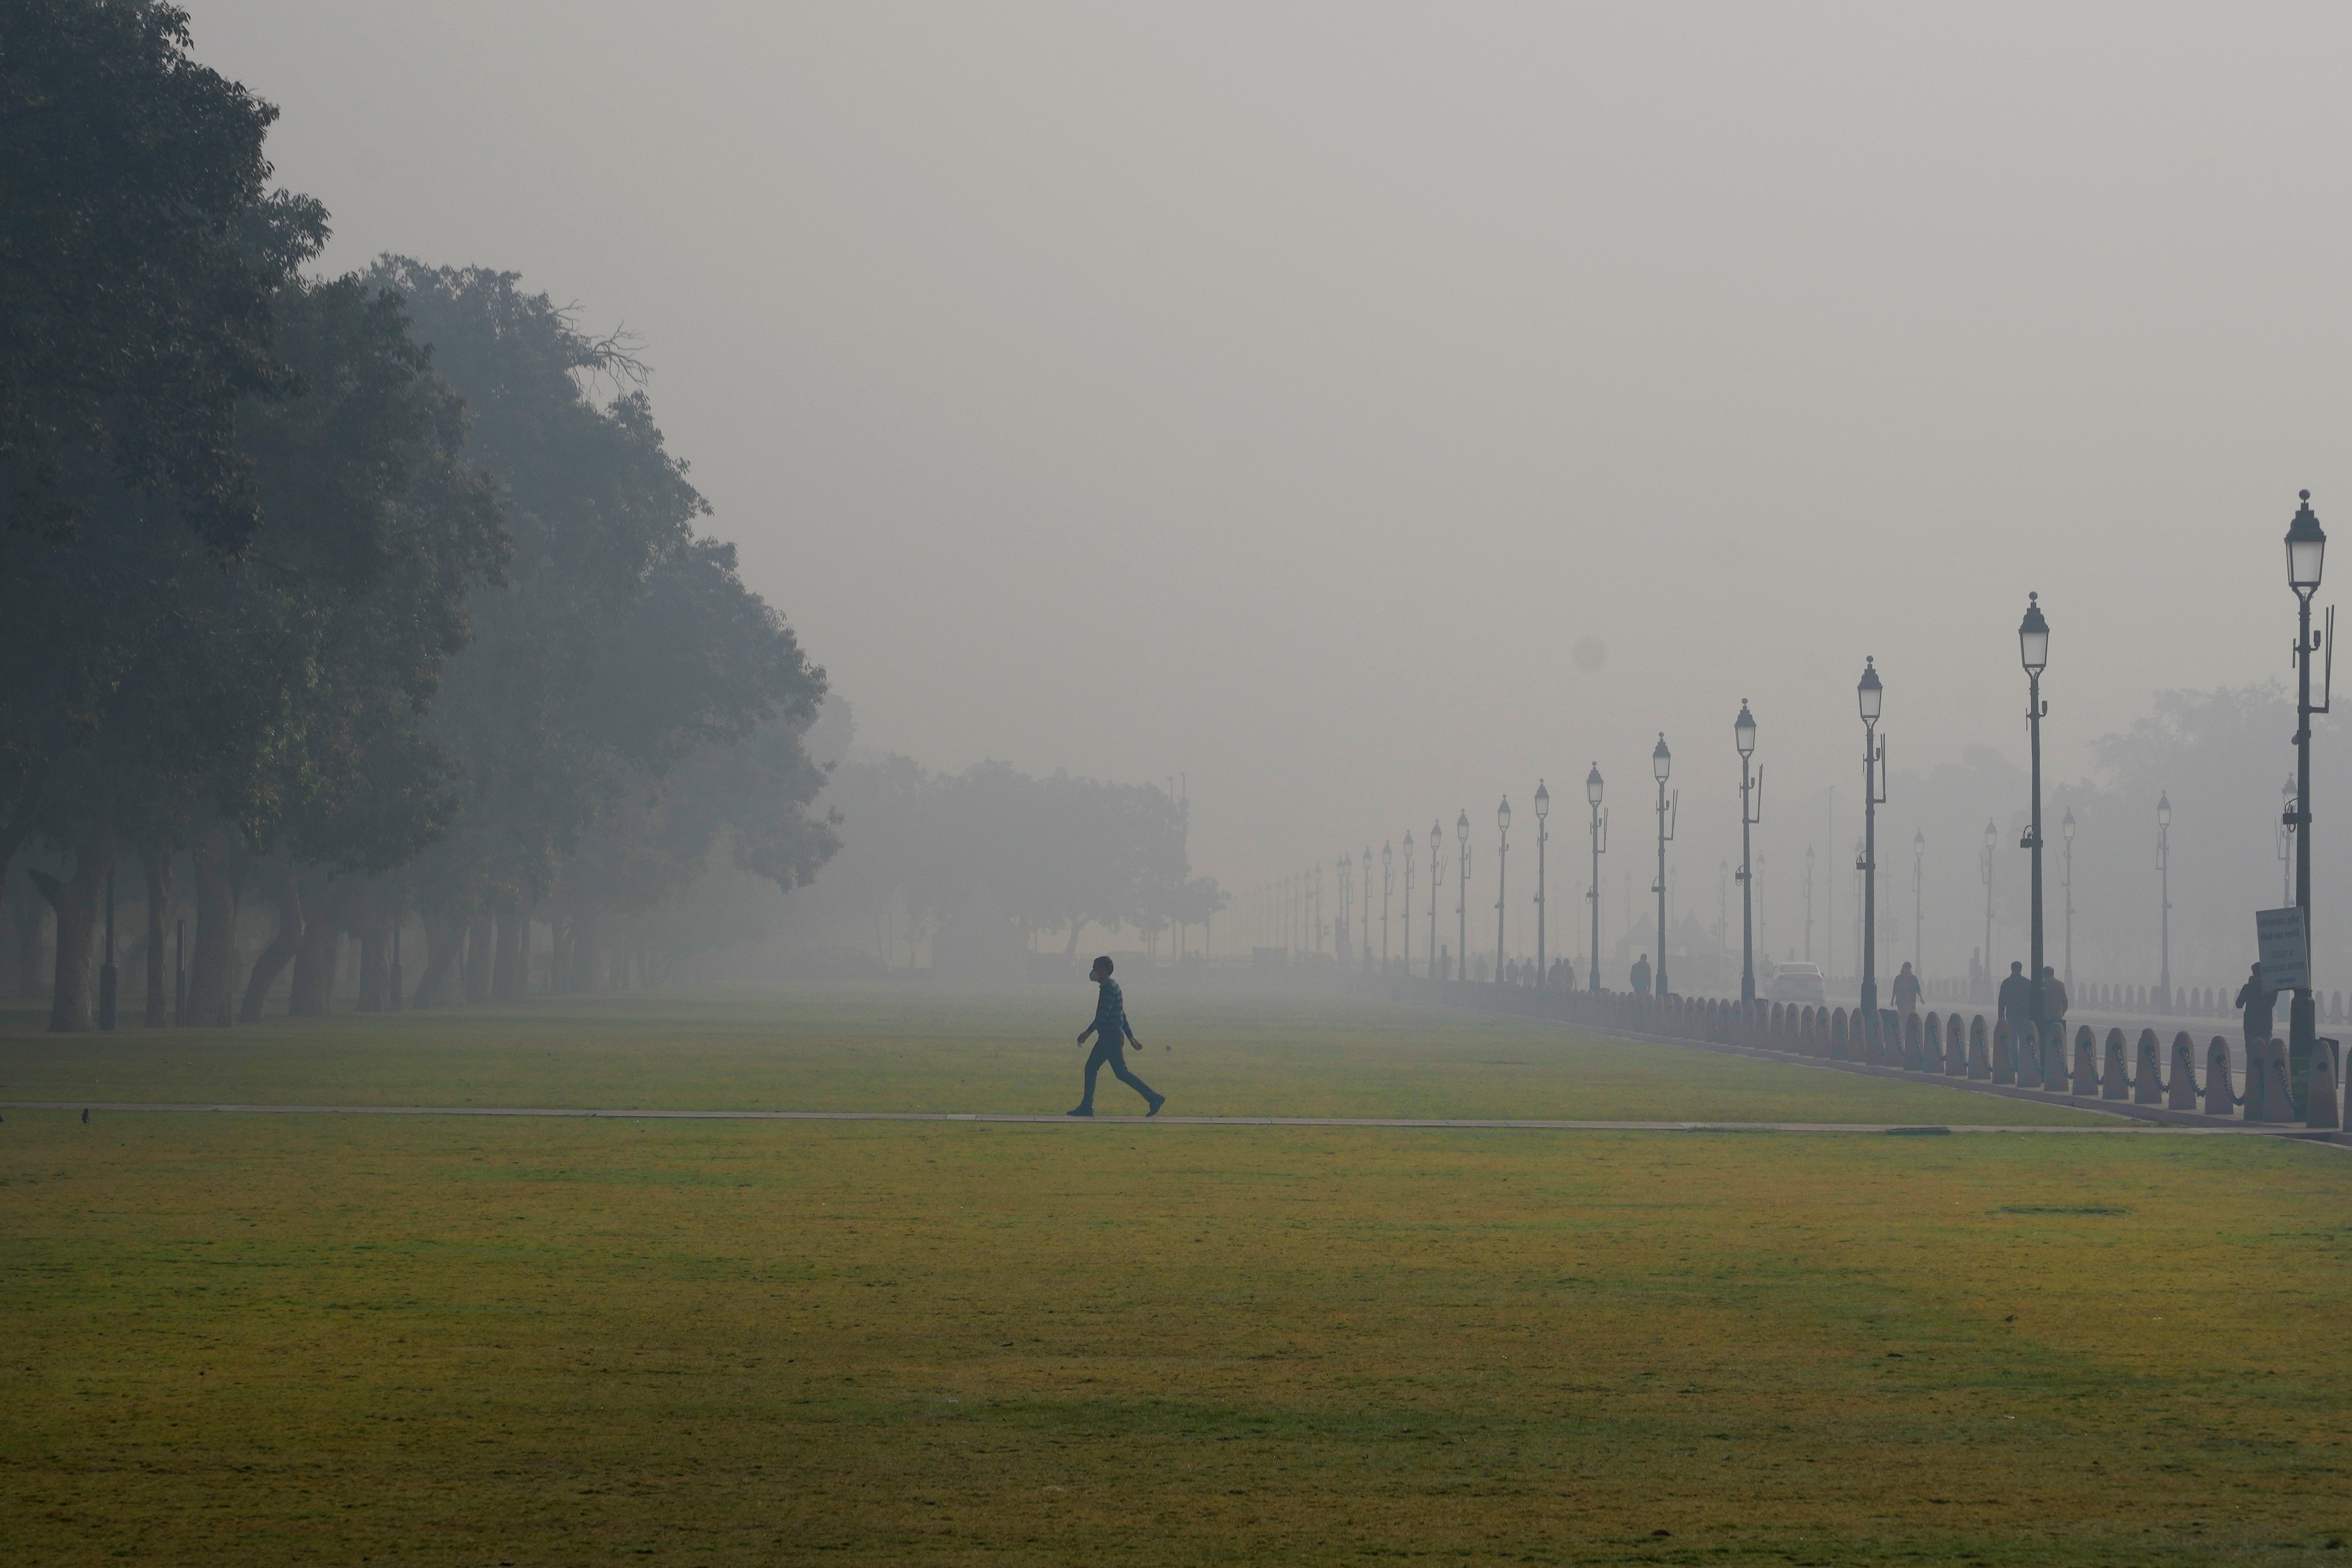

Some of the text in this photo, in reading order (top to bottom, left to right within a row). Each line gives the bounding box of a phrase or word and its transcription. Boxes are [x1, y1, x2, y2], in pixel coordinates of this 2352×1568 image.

[2271, 950, 2288, 959] TOILET
[2262, 961, 2305, 973] DRINKING WATER
